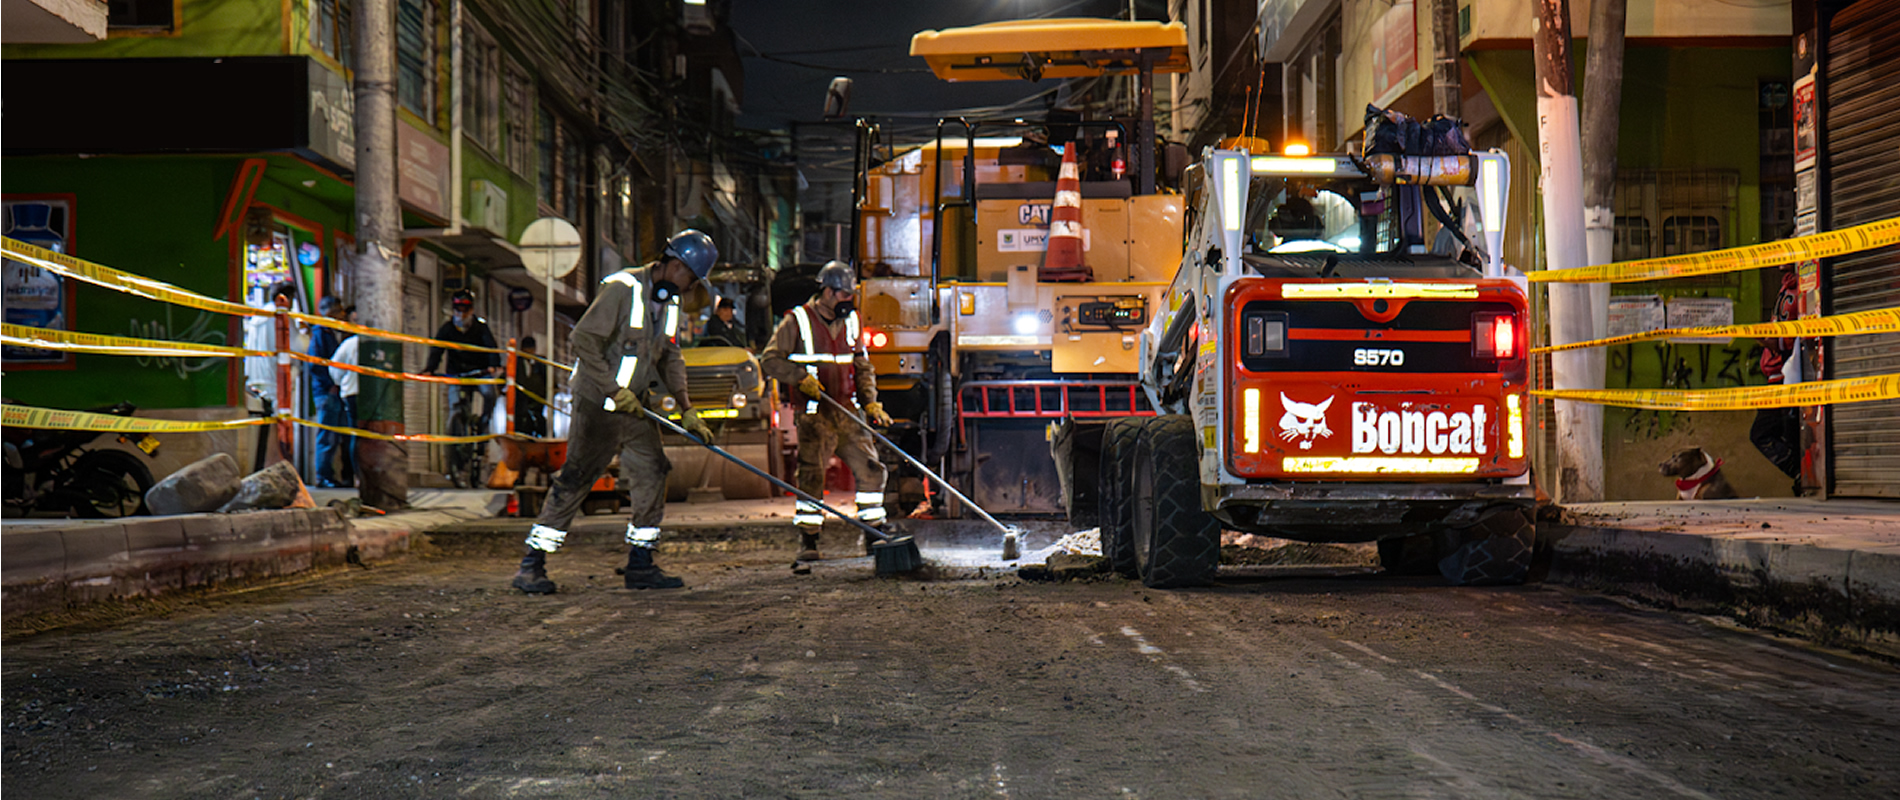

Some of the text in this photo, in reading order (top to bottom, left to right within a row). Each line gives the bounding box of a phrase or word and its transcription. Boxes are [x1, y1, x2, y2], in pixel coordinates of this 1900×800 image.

[1019, 204, 1051, 225] CAT
[1354, 349, 1404, 366] S570
[1352, 401, 1487, 454] Bobcat
